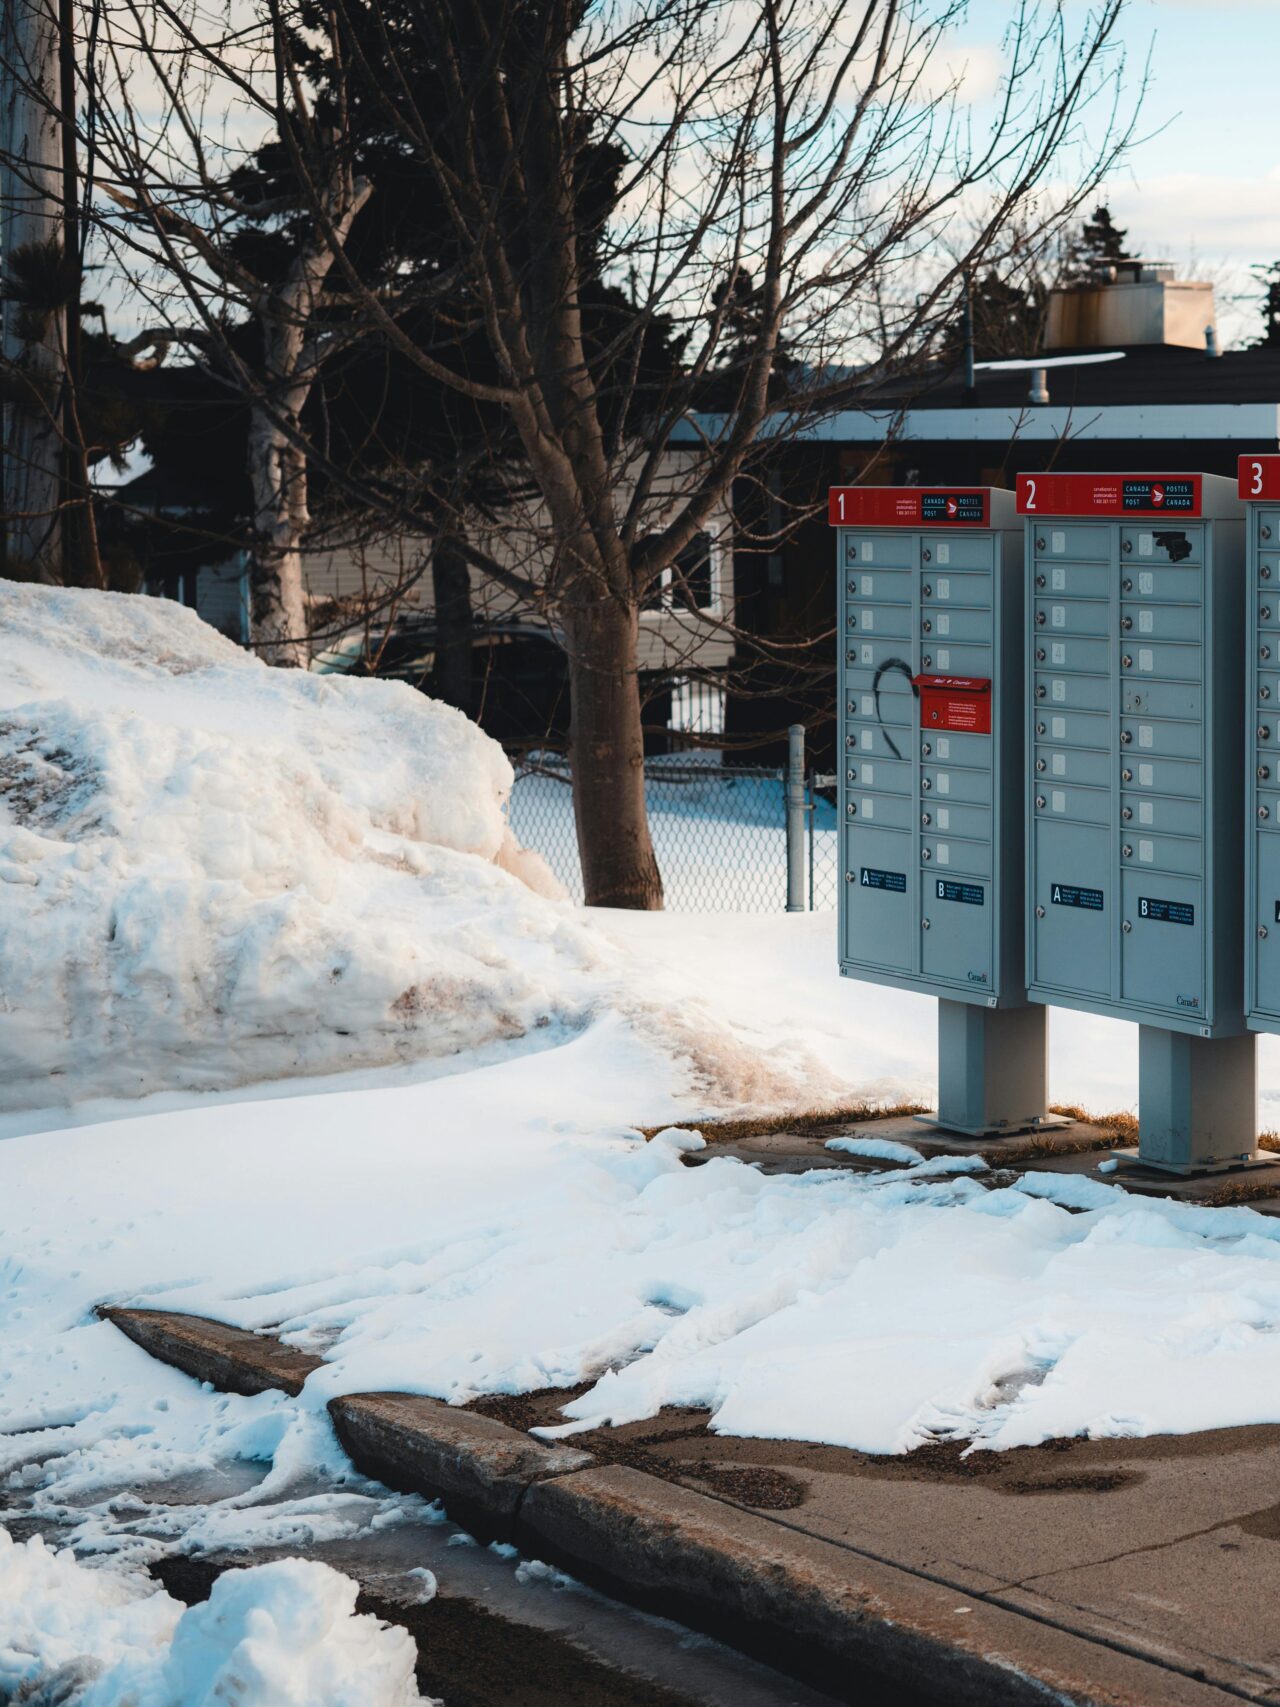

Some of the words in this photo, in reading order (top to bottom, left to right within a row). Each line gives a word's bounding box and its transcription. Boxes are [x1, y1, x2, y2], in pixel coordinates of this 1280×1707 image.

[1250, 463, 1263, 494] 3
[1026, 480, 1036, 509] 2
[837, 493, 845, 520] 1
[863, 870, 869, 884] A
[939, 882, 944, 897] B
[1054, 886, 1061, 902] A
[1142, 900, 1148, 915] B
[968, 970, 987, 983] Canada
[1176, 995, 1199, 1008] Canada
